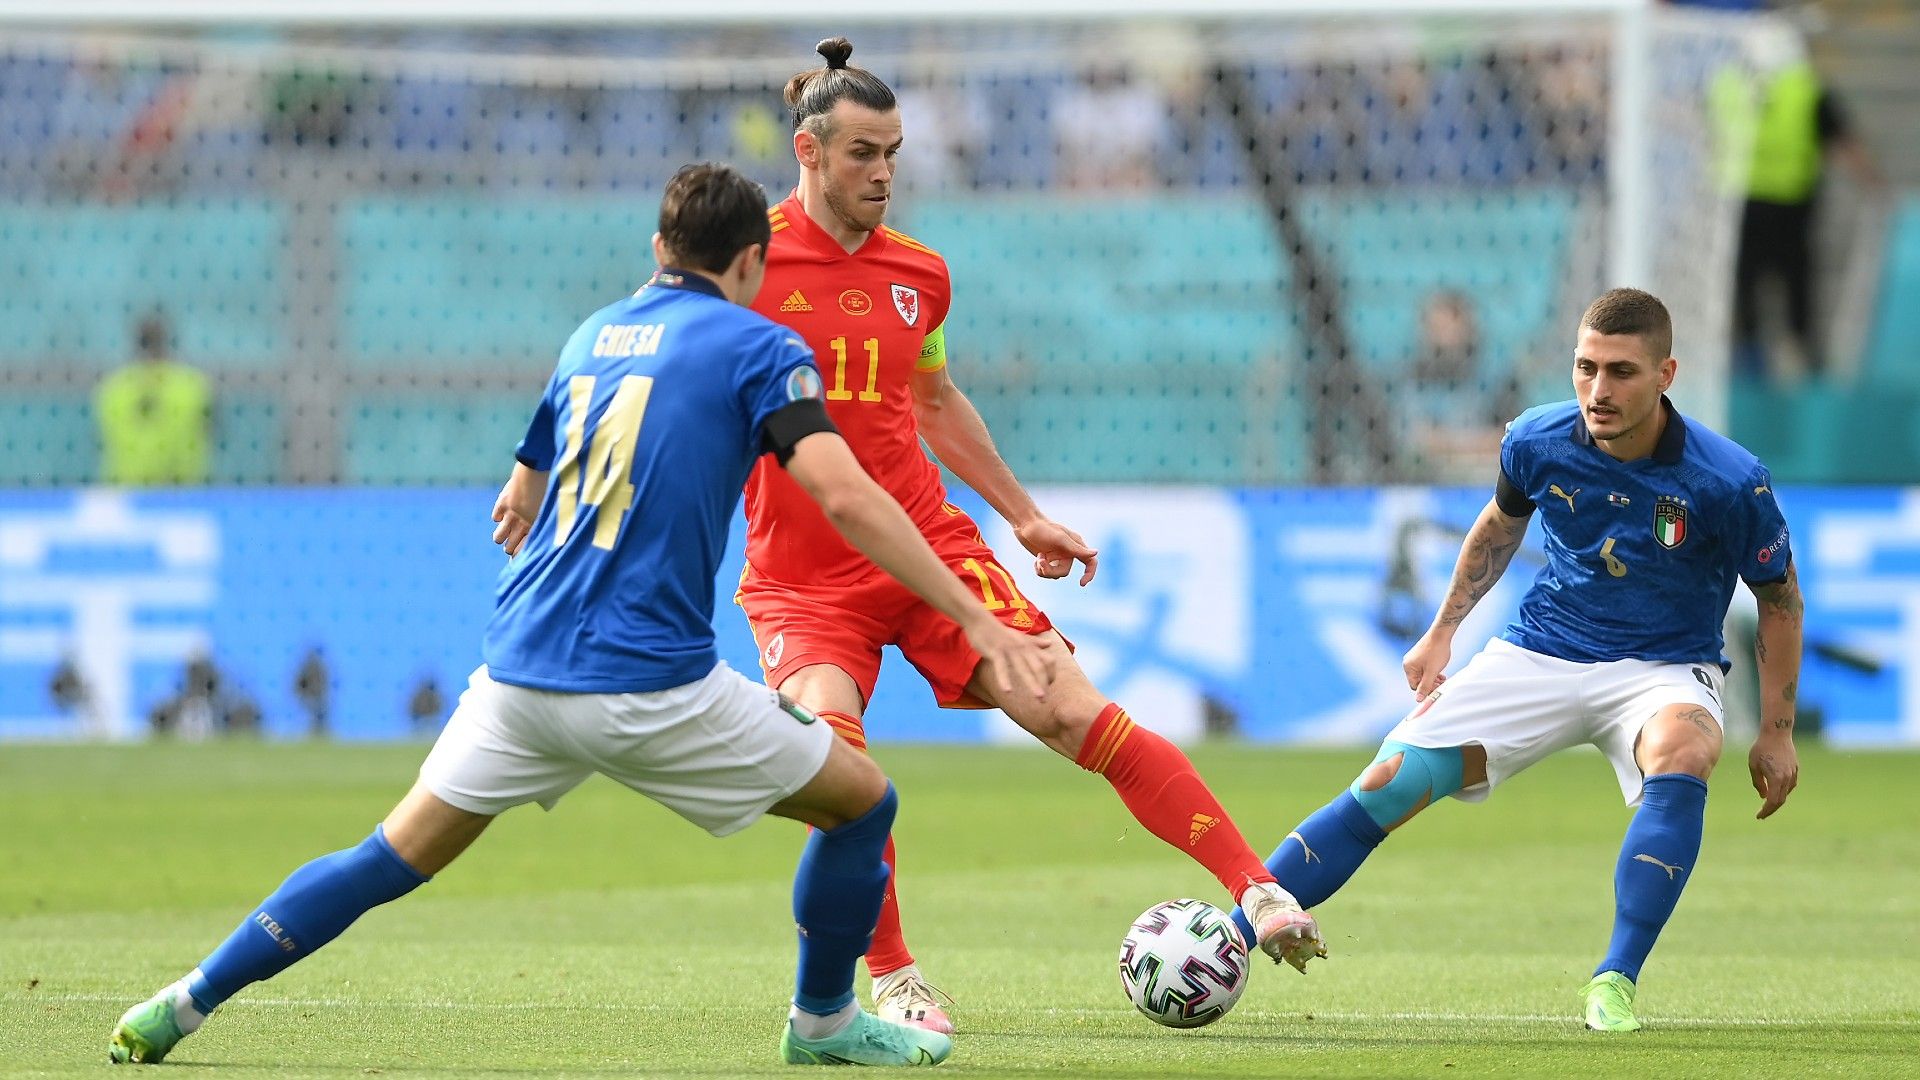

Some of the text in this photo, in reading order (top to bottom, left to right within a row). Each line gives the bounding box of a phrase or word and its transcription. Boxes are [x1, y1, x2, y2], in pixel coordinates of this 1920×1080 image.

[780, 303, 813, 312] adidas
[592, 323, 665, 357] CHIESA
[921, 343, 938, 356] ECT
[826, 336, 882, 402] 11
[553, 375, 654, 551] 14
[1658, 505, 1685, 517] ITALIA
[1600, 537, 1627, 577] 6
[962, 558, 1028, 611] 11
[1692, 667, 1714, 690] 6
[1190, 817, 1220, 846] adidas
[256, 911, 296, 951] ITALIA
